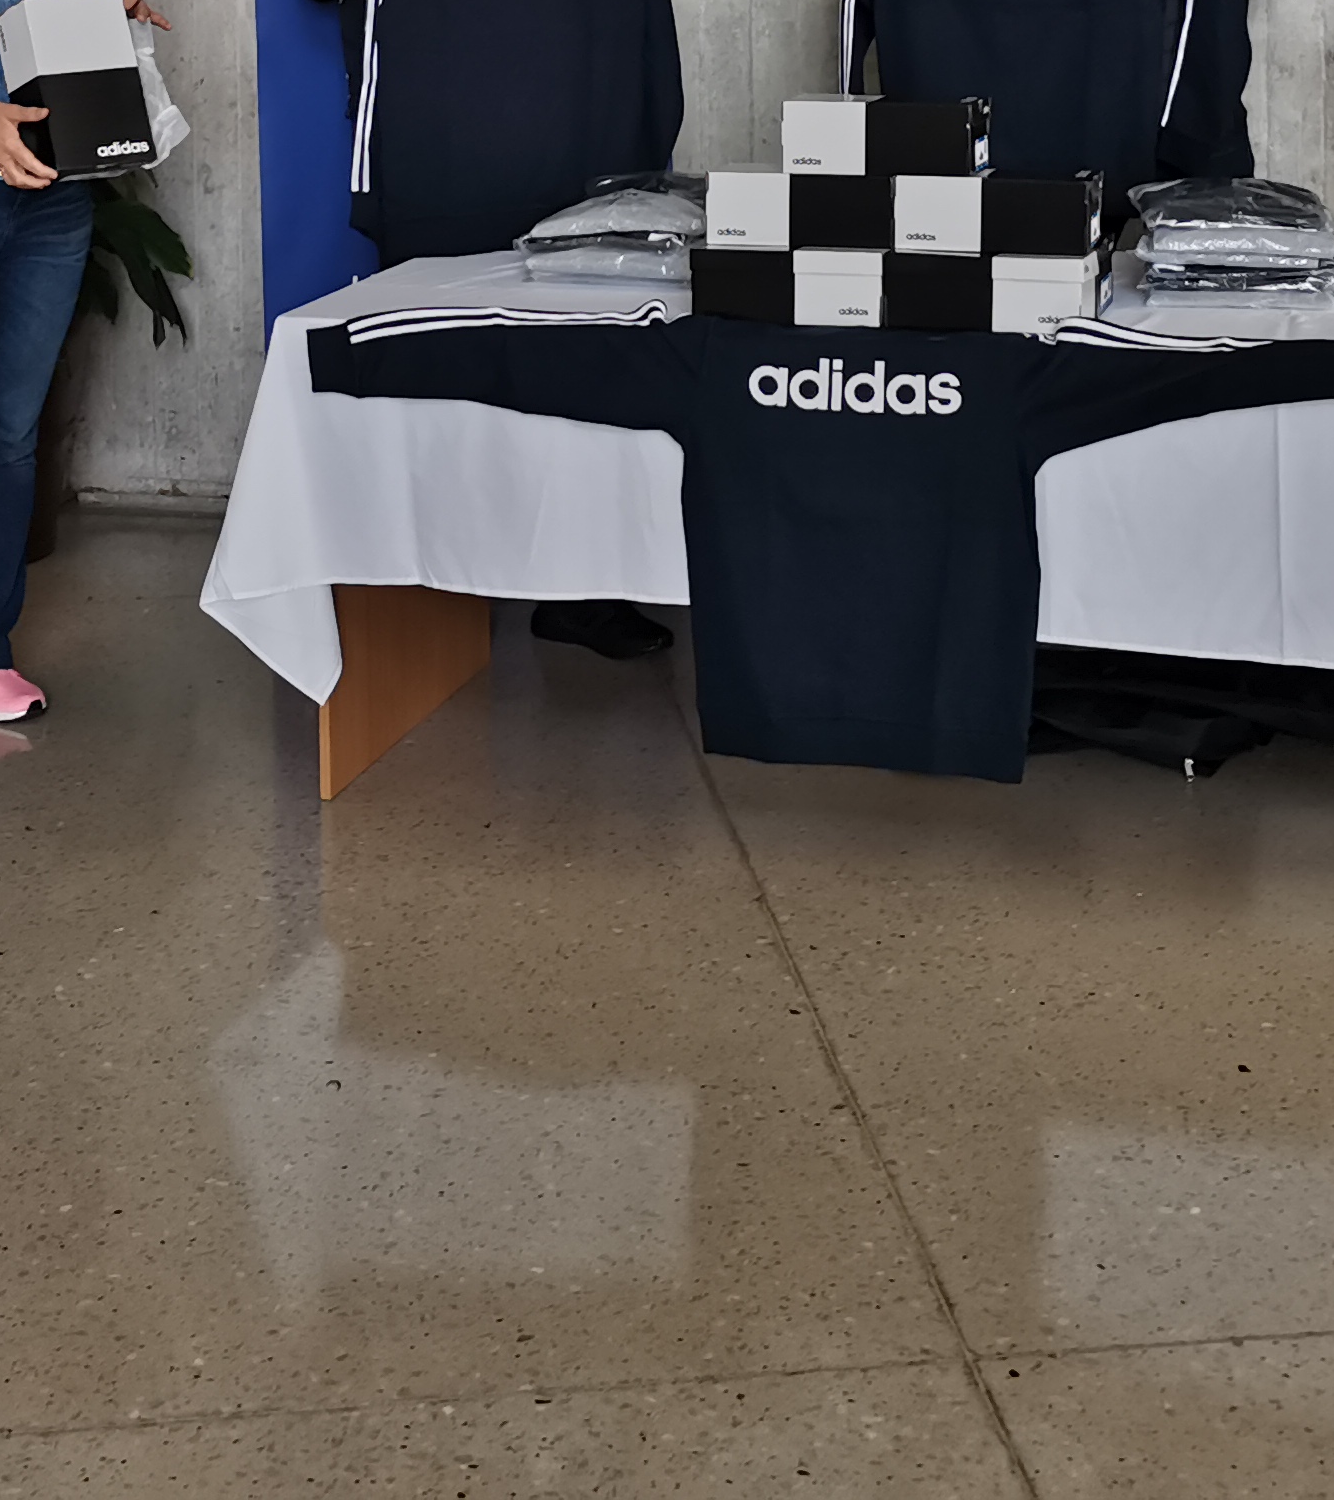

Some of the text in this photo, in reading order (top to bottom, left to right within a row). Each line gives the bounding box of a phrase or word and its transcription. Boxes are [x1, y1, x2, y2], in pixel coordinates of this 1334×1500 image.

[97, 140, 150, 157] adidas
[792, 157, 821, 165] adidas
[717, 228, 746, 236] adidas
[906, 233, 936, 241] adidas
[838, 307, 869, 316] adidas
[749, 358, 962, 415] adidas
